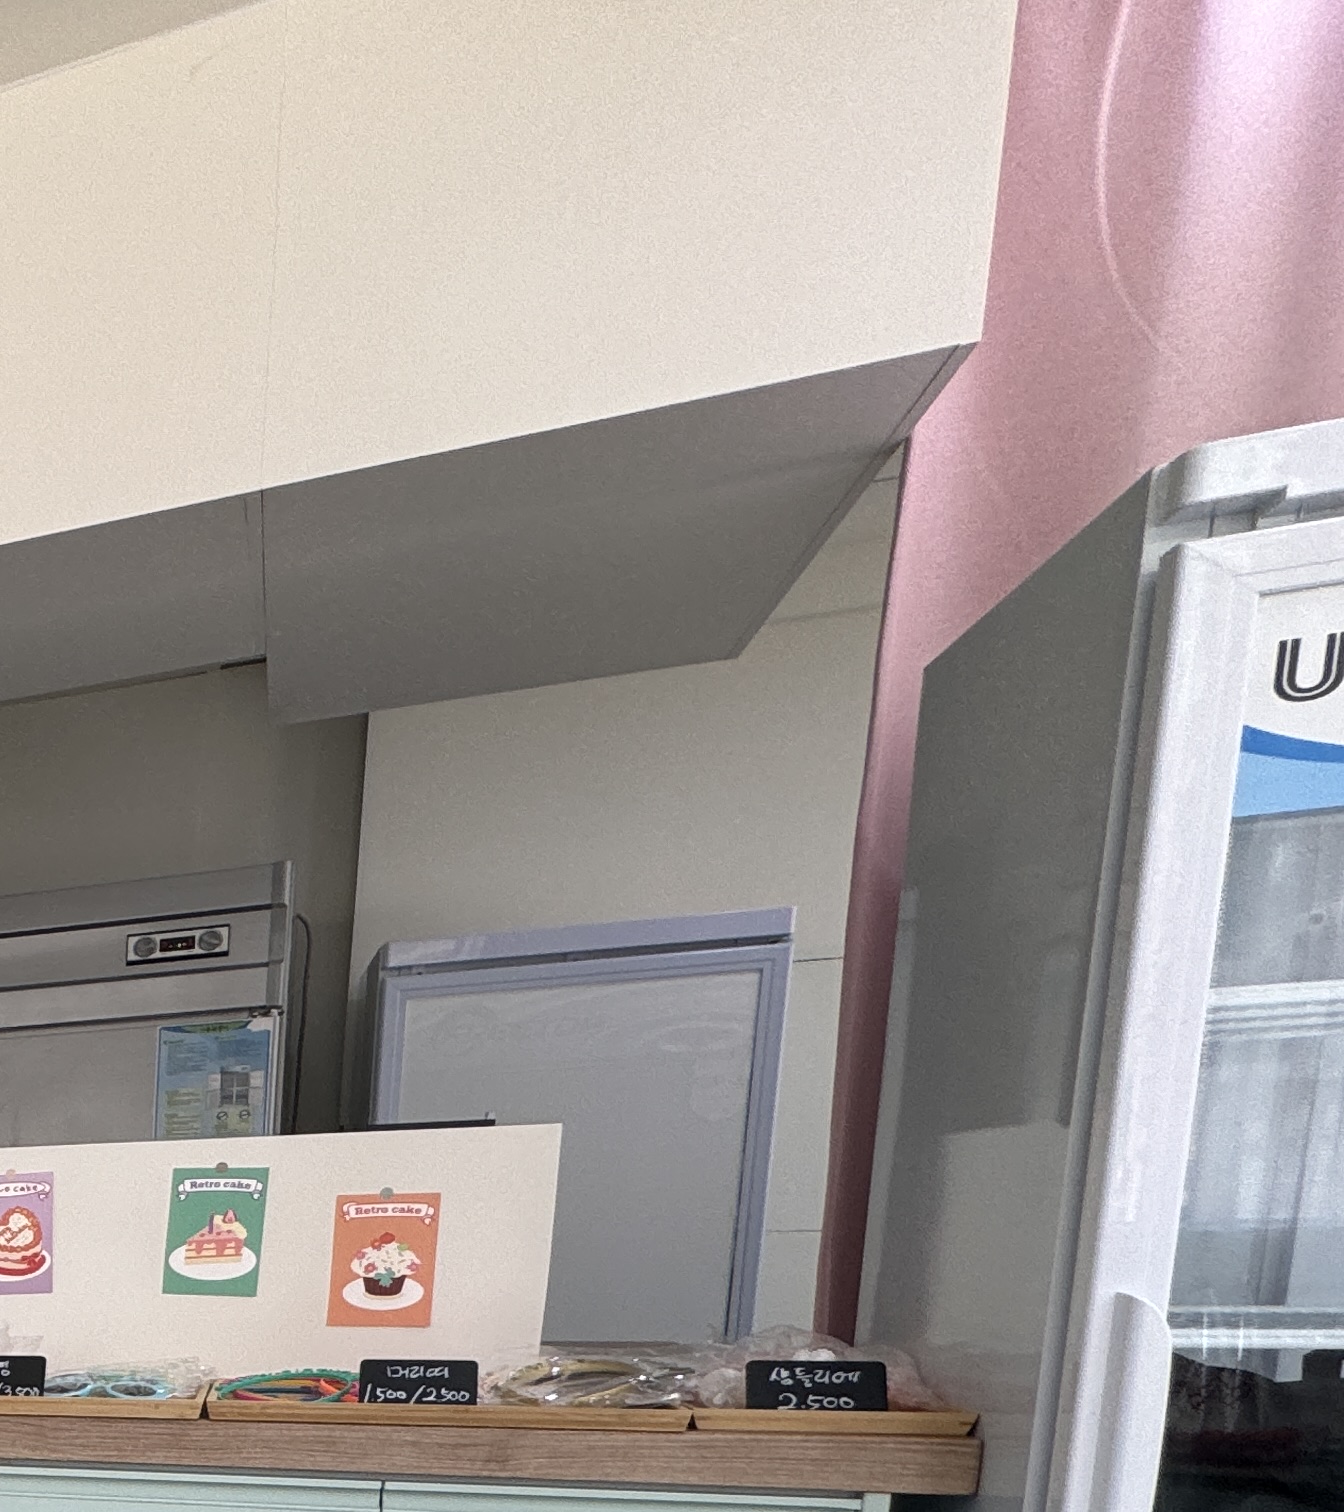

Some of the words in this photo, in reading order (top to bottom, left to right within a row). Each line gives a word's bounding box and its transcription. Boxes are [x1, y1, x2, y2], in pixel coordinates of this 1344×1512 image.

[12, 1184, 38, 1194] cake
[189, 1180, 221, 1190] Retro
[223, 1180, 252, 1190] cake
[354, 1206, 389, 1216] Retro
[391, 1205, 422, 1215] cake
[386, 1365, 450, 1378] 머리띠
[777, 1392, 855, 1410] 2.500
